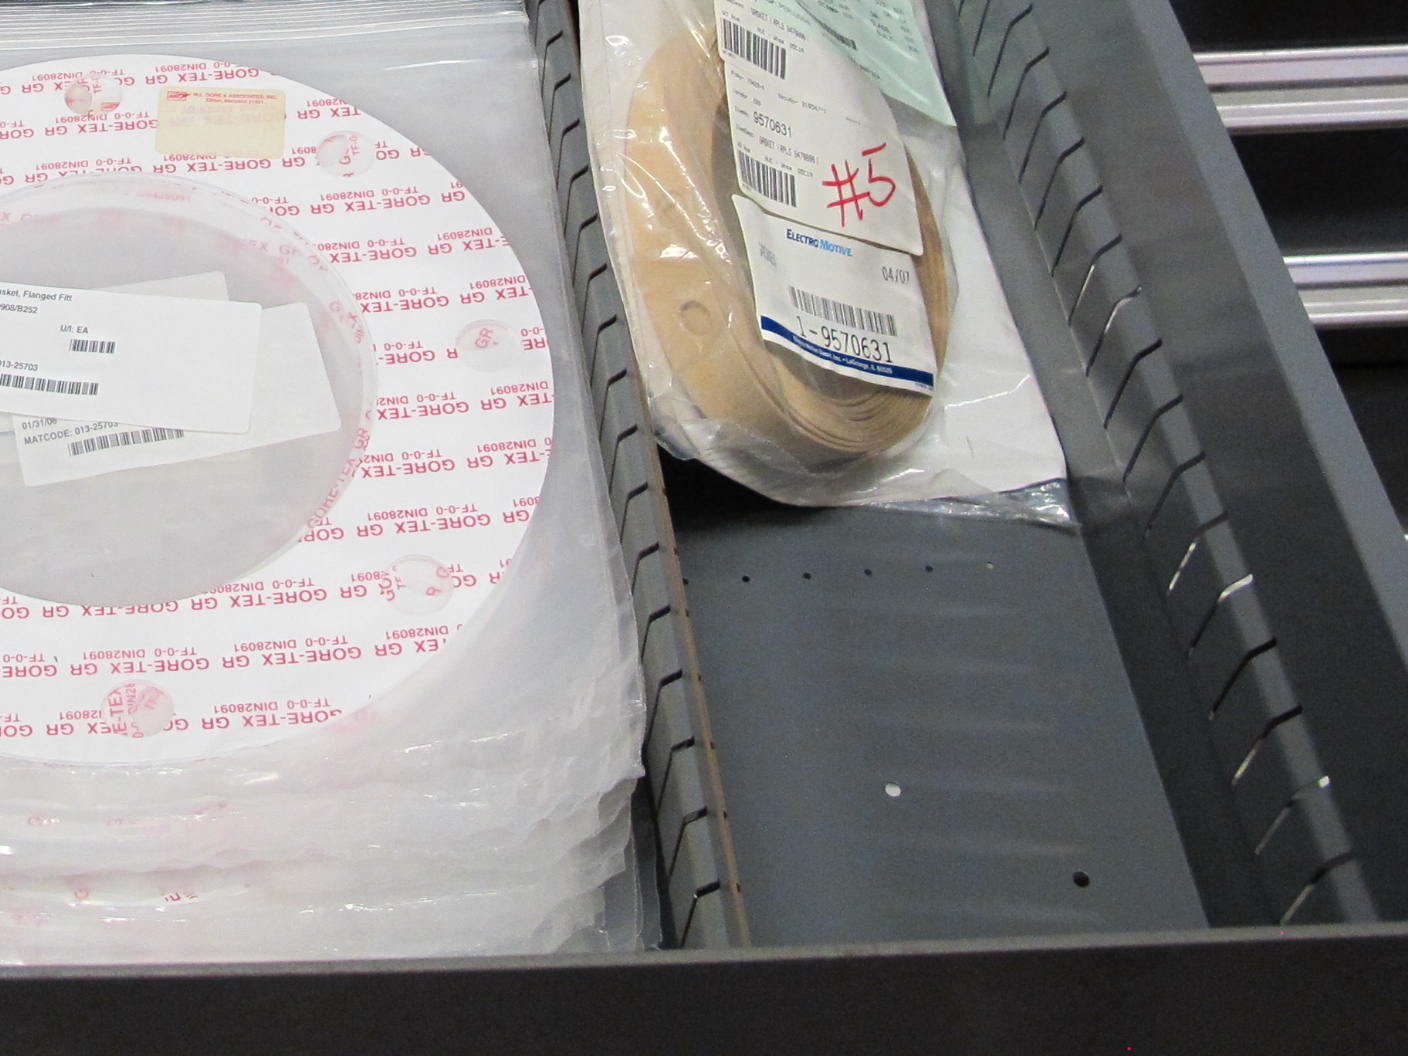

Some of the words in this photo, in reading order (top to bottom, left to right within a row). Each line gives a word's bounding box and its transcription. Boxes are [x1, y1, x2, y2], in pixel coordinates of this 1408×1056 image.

[156, 62, 206, 72] DIN28091
[146, 74, 168, 84] GR
[178, 68, 260, 82] GORE-TEX
[114, 111, 150, 119] TF-0-0
[753, 111, 792, 138] 9570631
[153, 164, 176, 174] GR
[822, 142, 896, 227] #5
[438, 227, 493, 241] DIN28091
[882, 267, 910, 284] 04/07
[23, 290, 56, 302] Flanged
[76, 326, 89, 334] EA
[378, 402, 469, 420] GORE-TEX
[24, 430, 73, 445] MATCODE:
[402, 449, 442, 460] TF-0-0
[362, 458, 455, 478] GORE-TEX
[396, 514, 490, 534] GORE-TEX
[230, 588, 327, 608] GORE-TEX
[262, 647, 362, 666] GORE-TEX
[46, 723, 74, 736] GR
